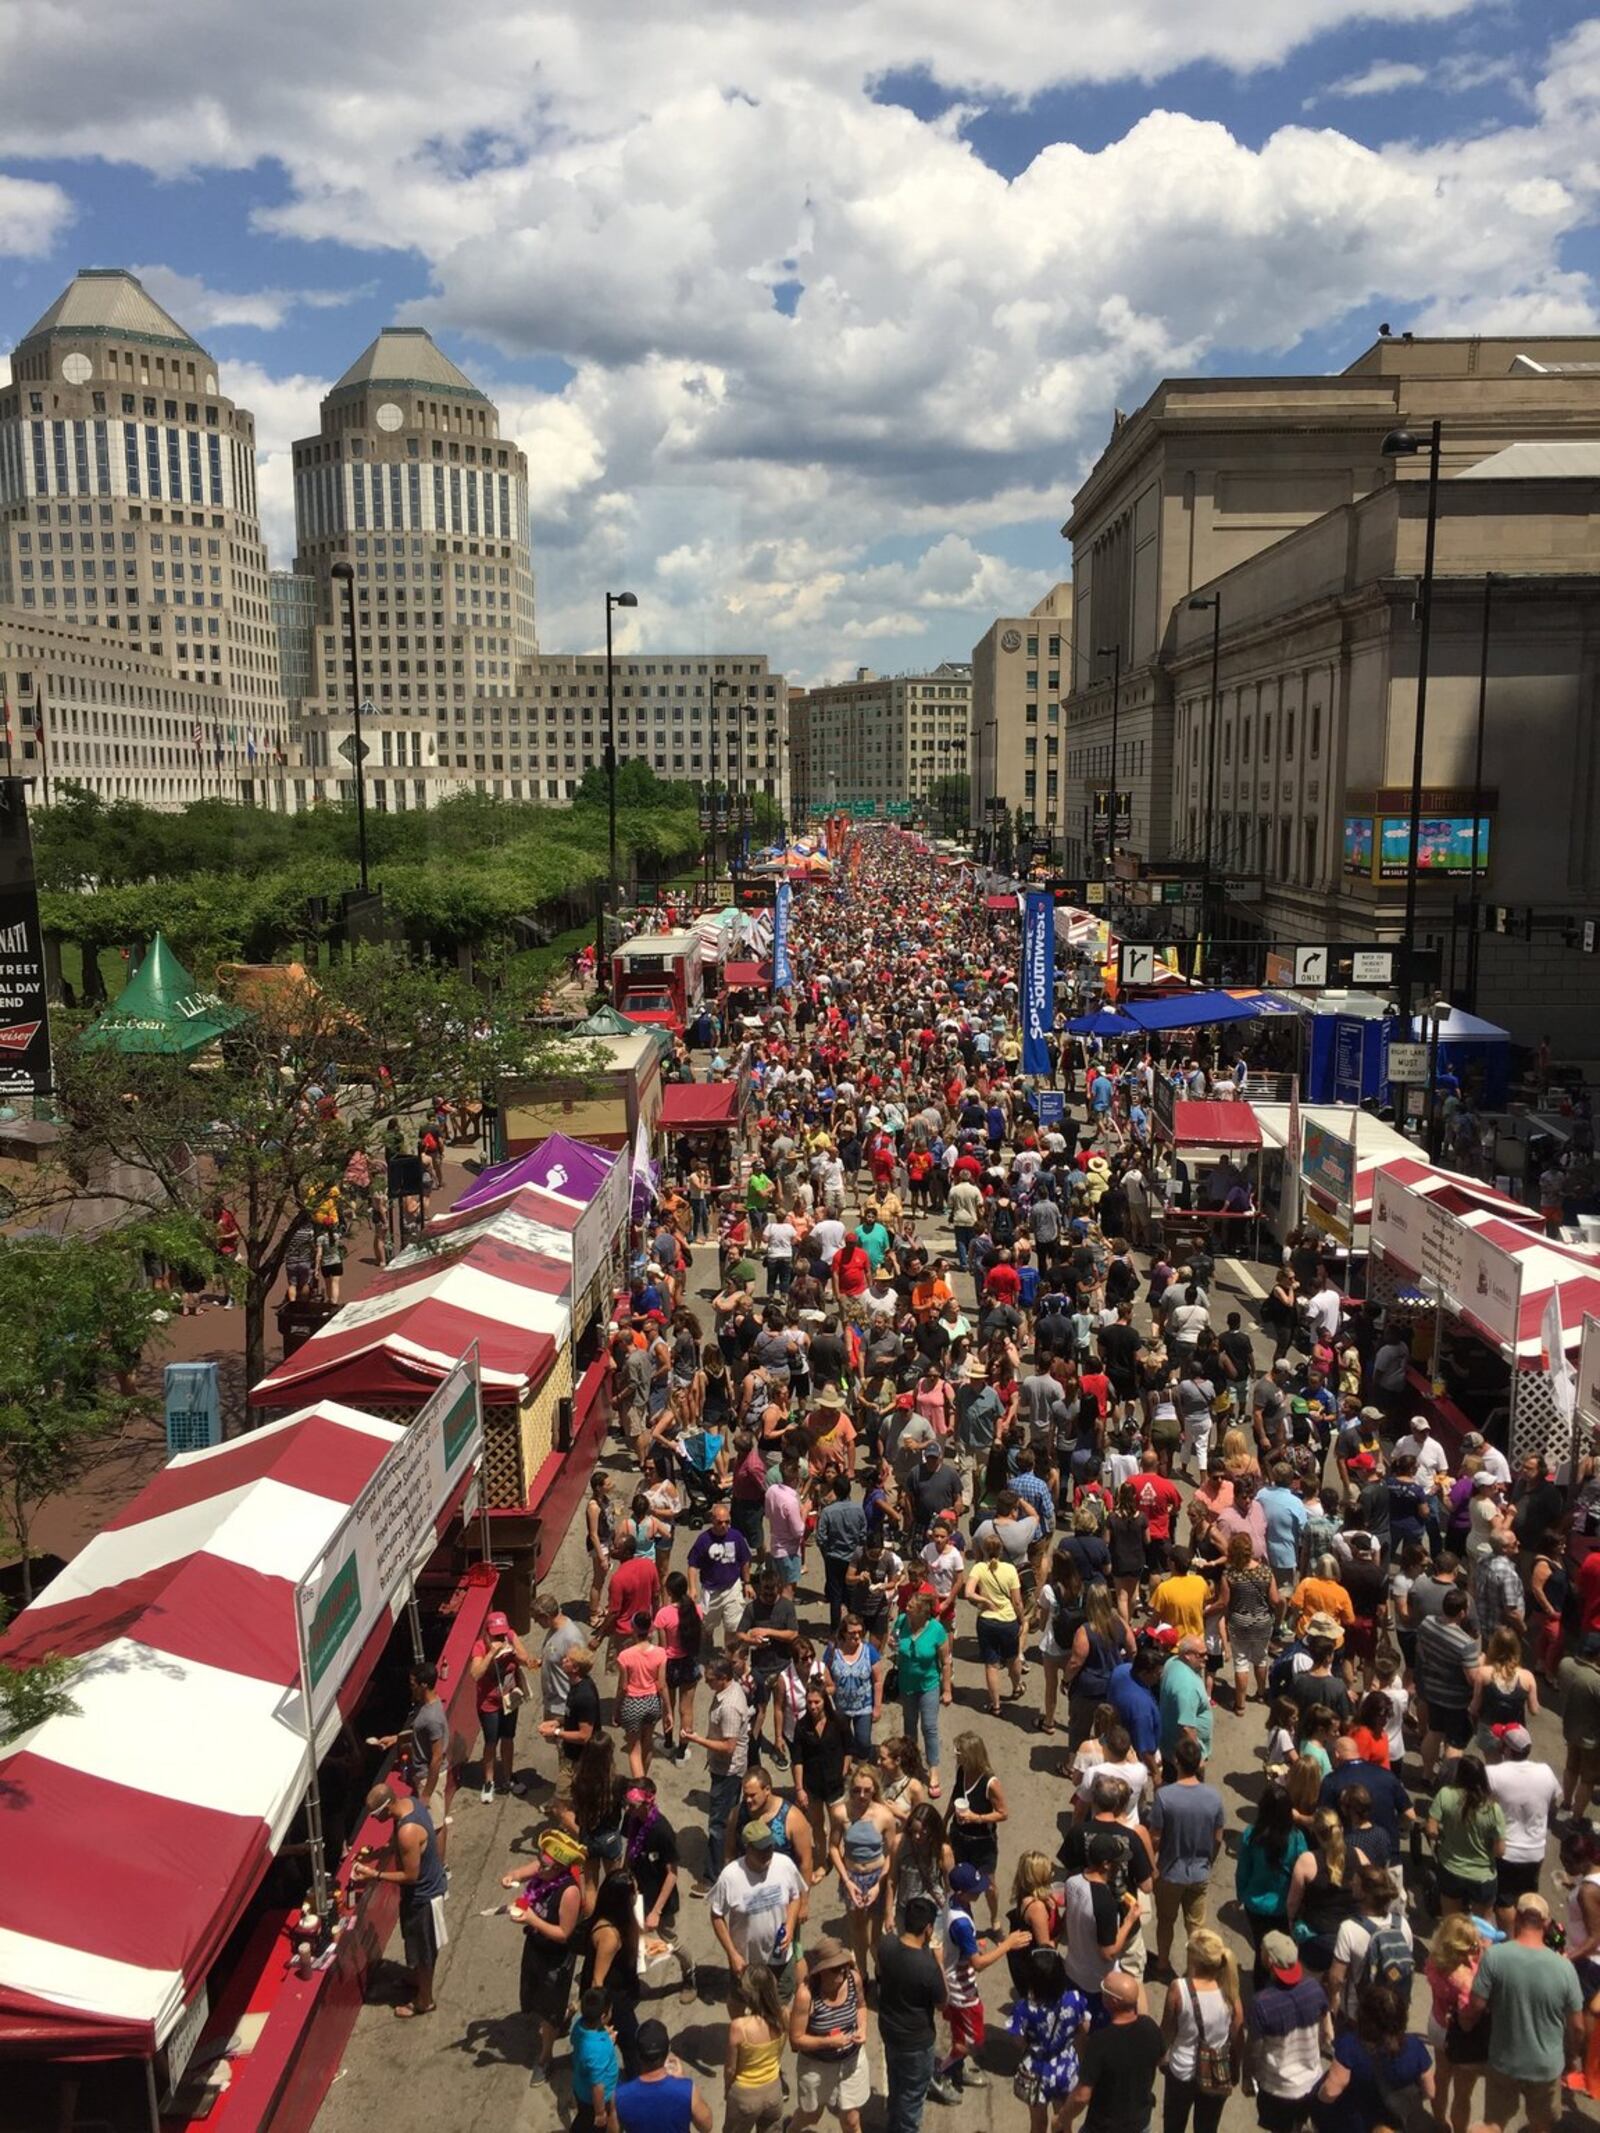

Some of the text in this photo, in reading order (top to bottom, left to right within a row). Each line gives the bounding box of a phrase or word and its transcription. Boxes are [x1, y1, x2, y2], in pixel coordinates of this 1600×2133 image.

[778, 897, 788, 944] LIGHT
[1033, 911, 1046, 1010] Southwest
[1301, 974, 1321, 983] ONLY
[16, 983, 41, 993] DAY
[1398, 1059, 1418, 1067] MUST
